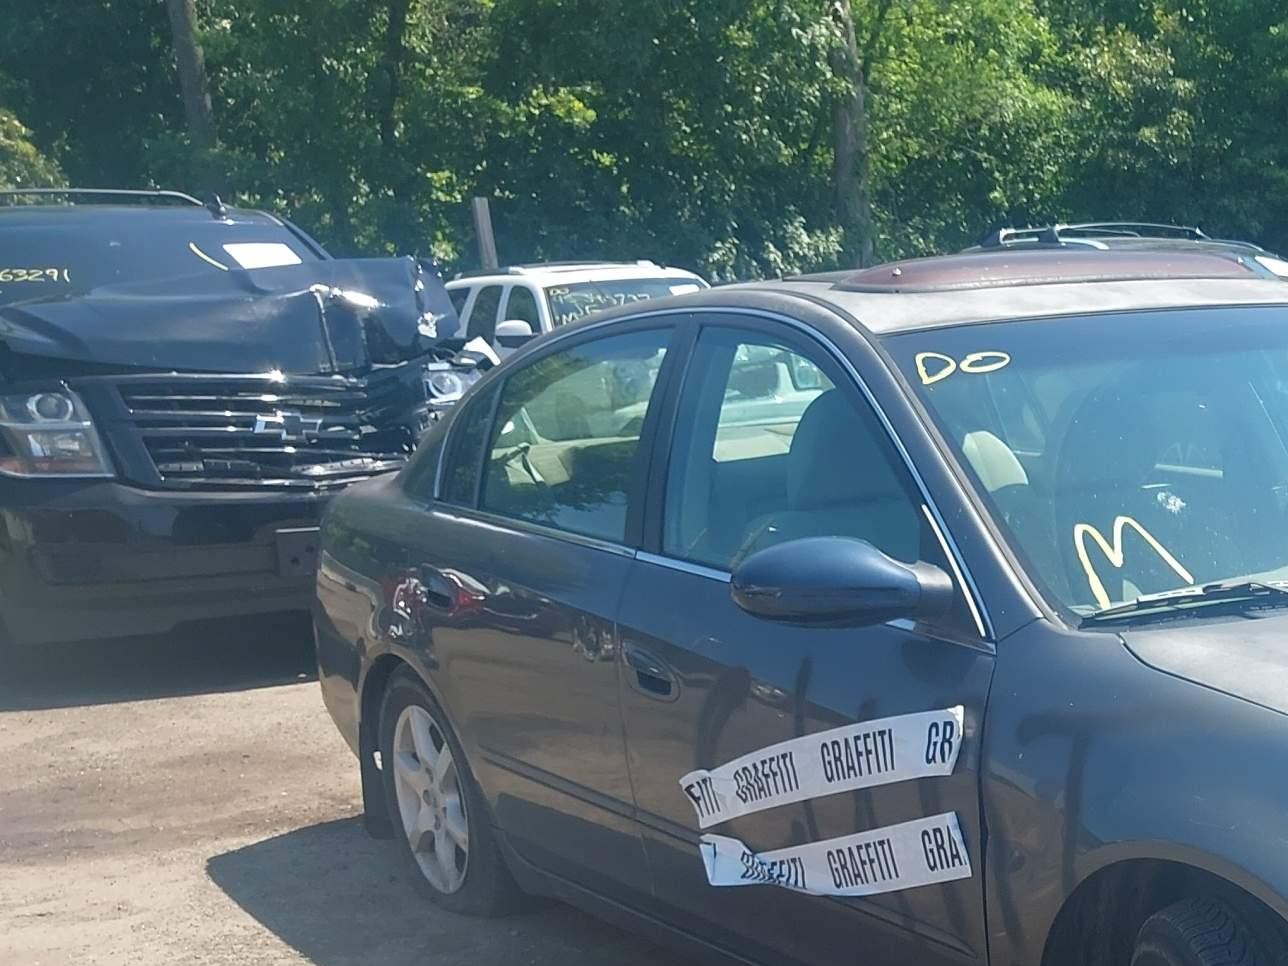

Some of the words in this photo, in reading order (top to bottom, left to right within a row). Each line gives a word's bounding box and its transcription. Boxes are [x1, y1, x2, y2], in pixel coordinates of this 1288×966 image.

[914, 350, 1012, 385] DO
[1073, 515, 1196, 610] M
[734, 751, 800, 805] GRAFFITI
[820, 728, 897, 784] GRAFFITI
[925, 720, 955, 765] GR
[826, 838, 900, 889] GRAFFITI
[921, 824, 968, 872] GRA
